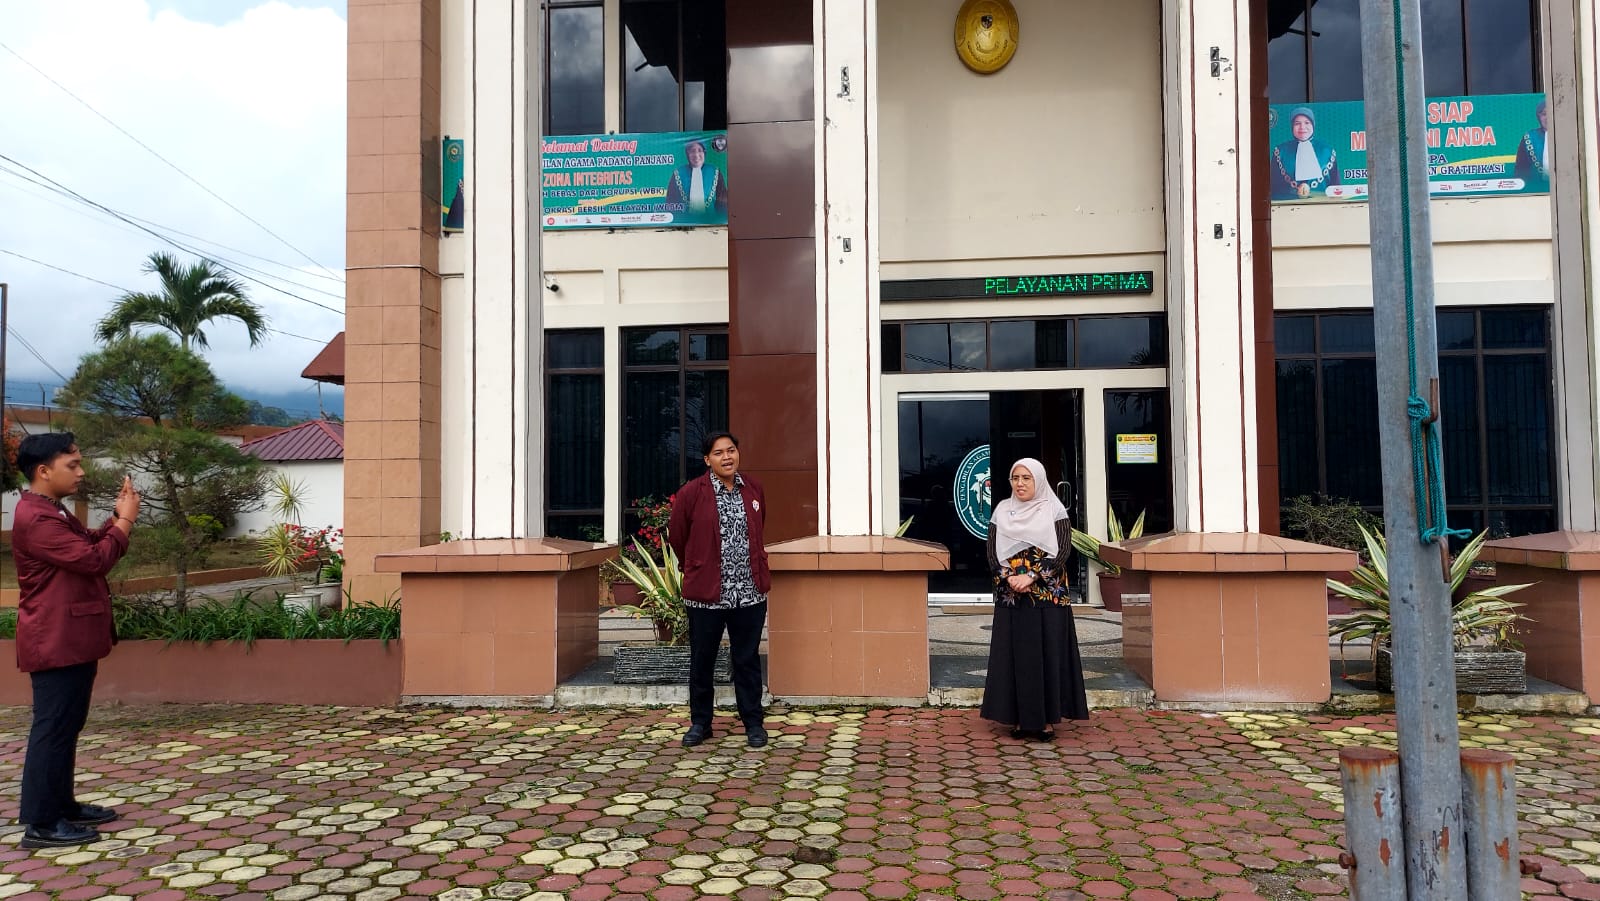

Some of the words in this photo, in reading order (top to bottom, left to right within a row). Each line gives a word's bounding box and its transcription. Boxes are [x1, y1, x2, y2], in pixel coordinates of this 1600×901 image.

[1428, 101, 1473, 124] SIAP
[1445, 126, 1496, 148] ANDA
[591, 137, 638, 155] Datang
[564, 157, 595, 168] AGAMA
[597, 156, 632, 167] PADANG
[634, 154, 674, 165] PANJANG
[1440, 163, 1505, 176] GRATIFIKASI
[543, 173, 571, 187] ZONA
[573, 170, 633, 187] INTEGRITAS
[551, 189, 577, 198] BEBAS
[579, 188, 599, 197] DARI
[601, 187, 638, 197] KORUPSI
[640, 186, 665, 197] (WBK)
[577, 205, 606, 214] BERSIH
[608, 203, 651, 213] MELAYANI
[985, 275, 1087, 295] PELAYANAN
[1092, 272, 1148, 290] PRIMA
